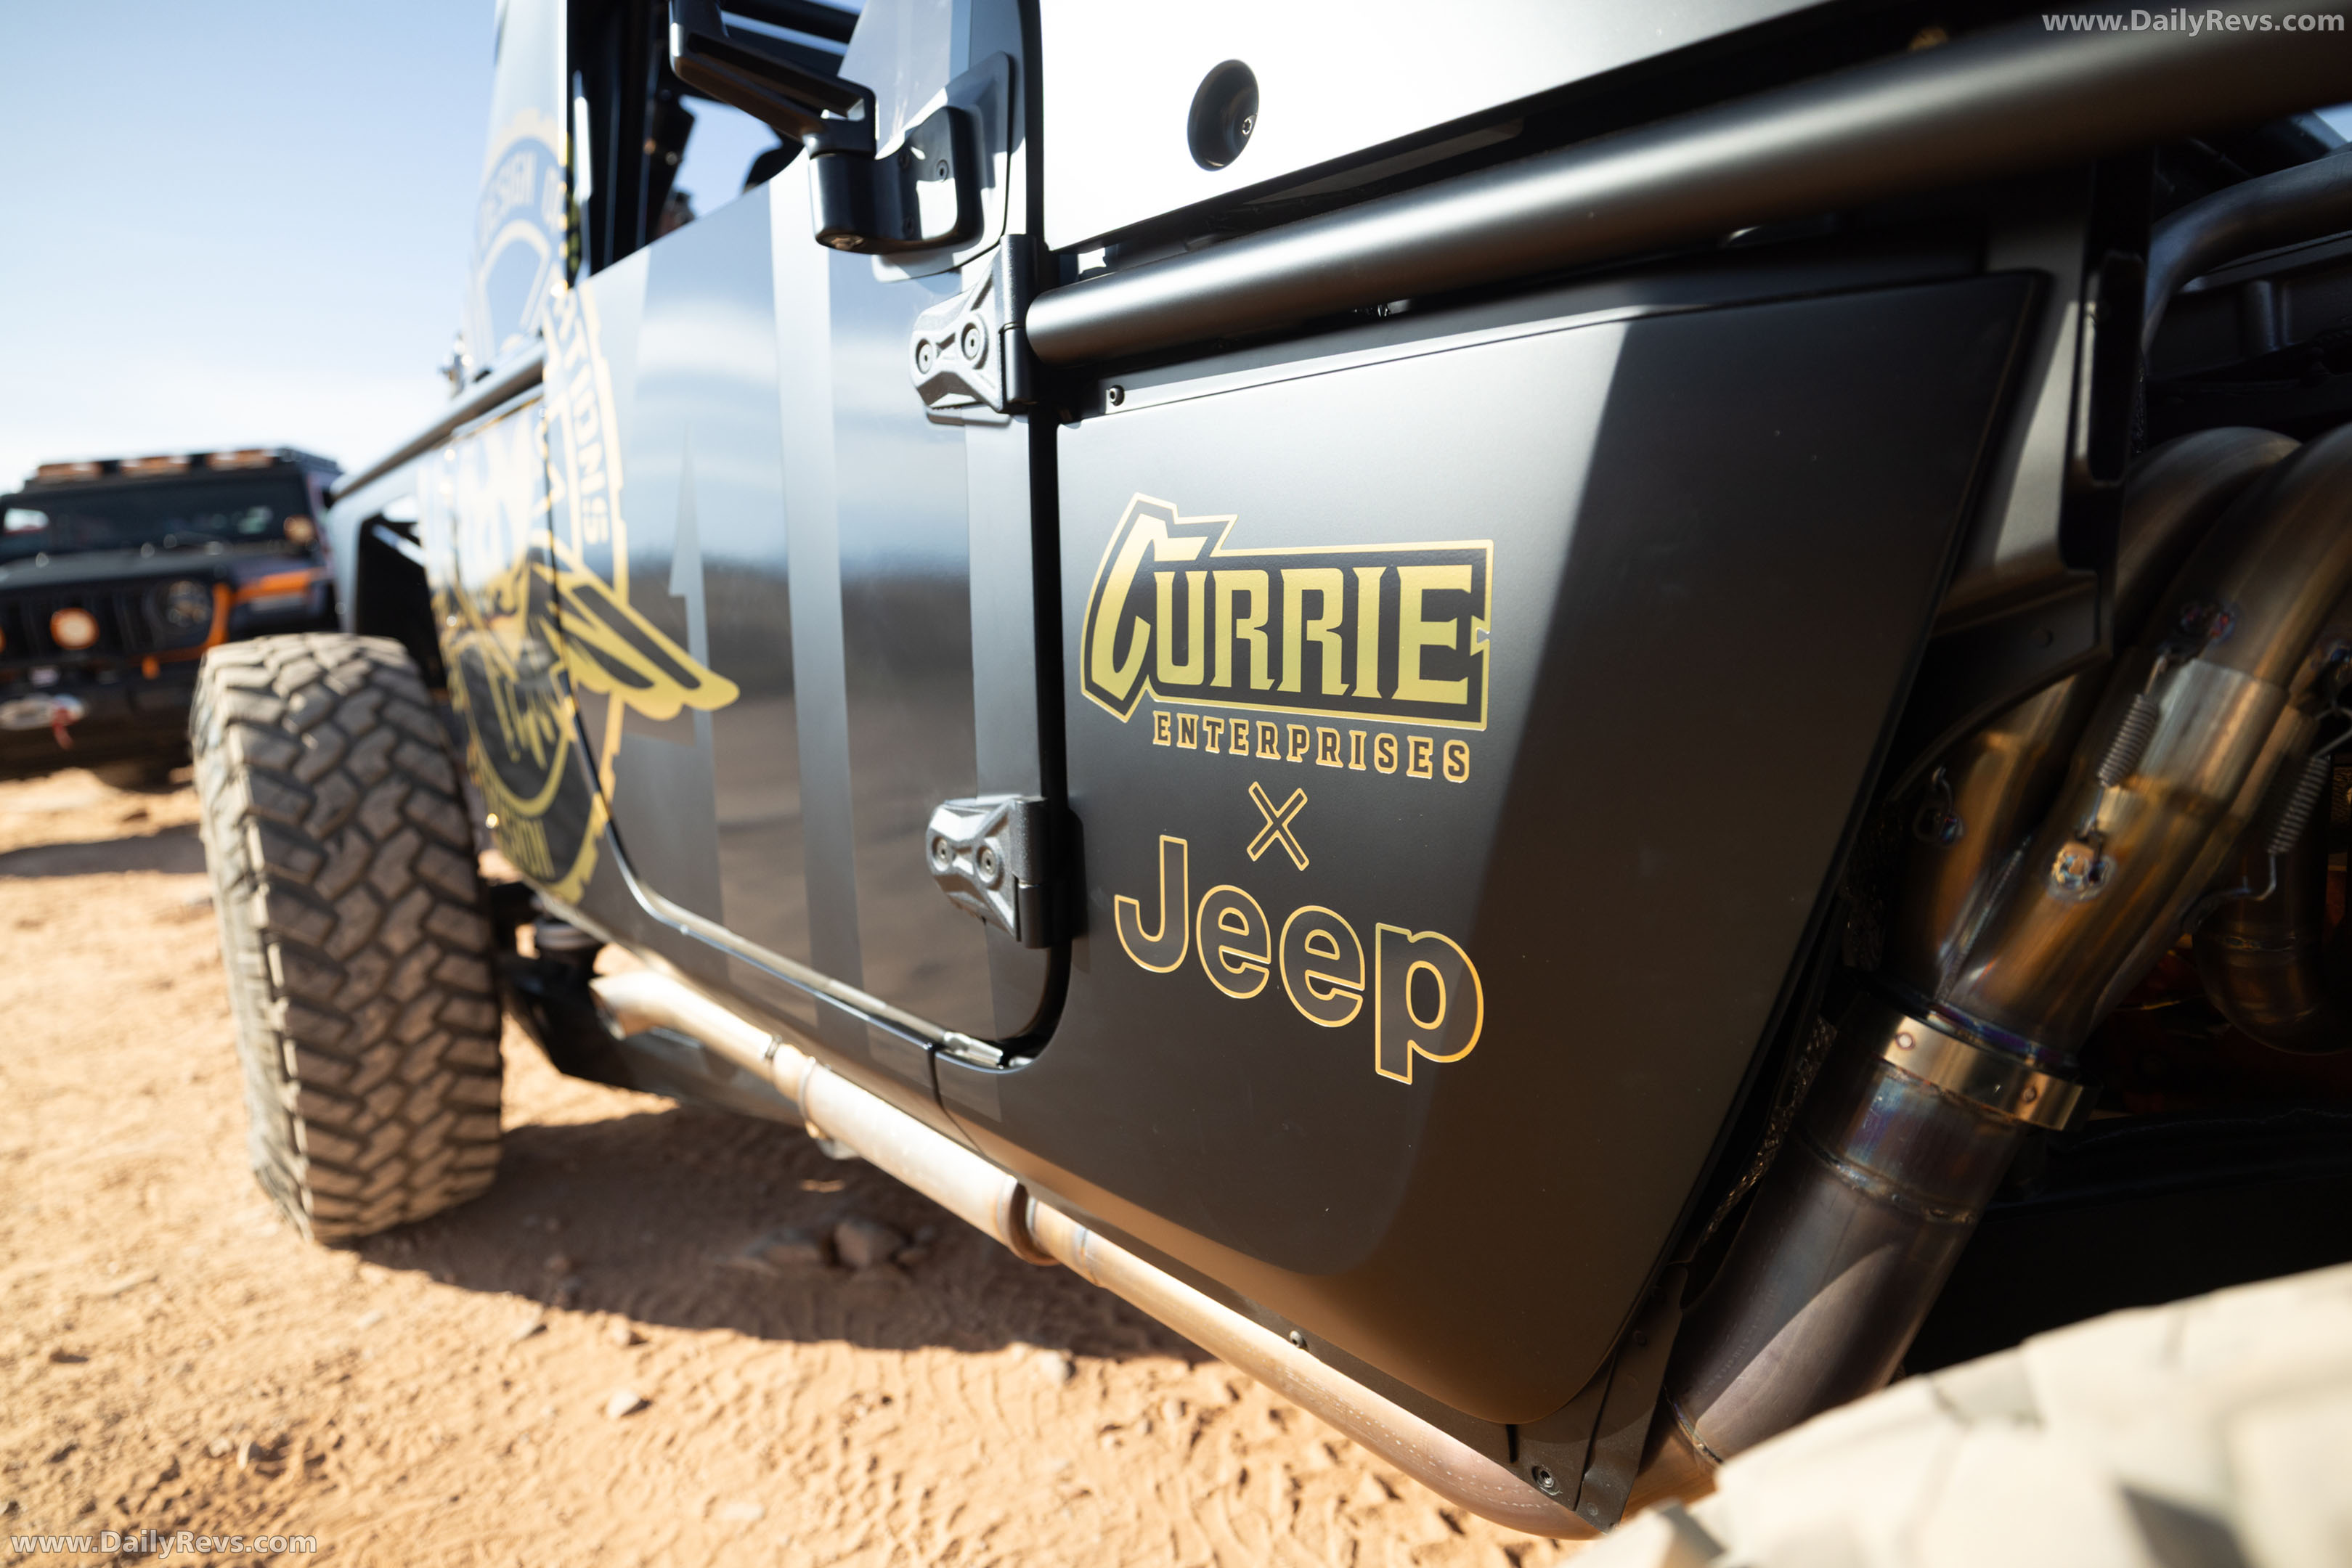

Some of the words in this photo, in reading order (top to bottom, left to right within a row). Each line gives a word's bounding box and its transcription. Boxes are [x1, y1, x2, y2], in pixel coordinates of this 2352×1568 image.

[1091, 513, 1473, 705] CURRIE
[1152, 710, 1470, 784] ENTERPRISES
[1114, 834, 1484, 1086] Jeep
